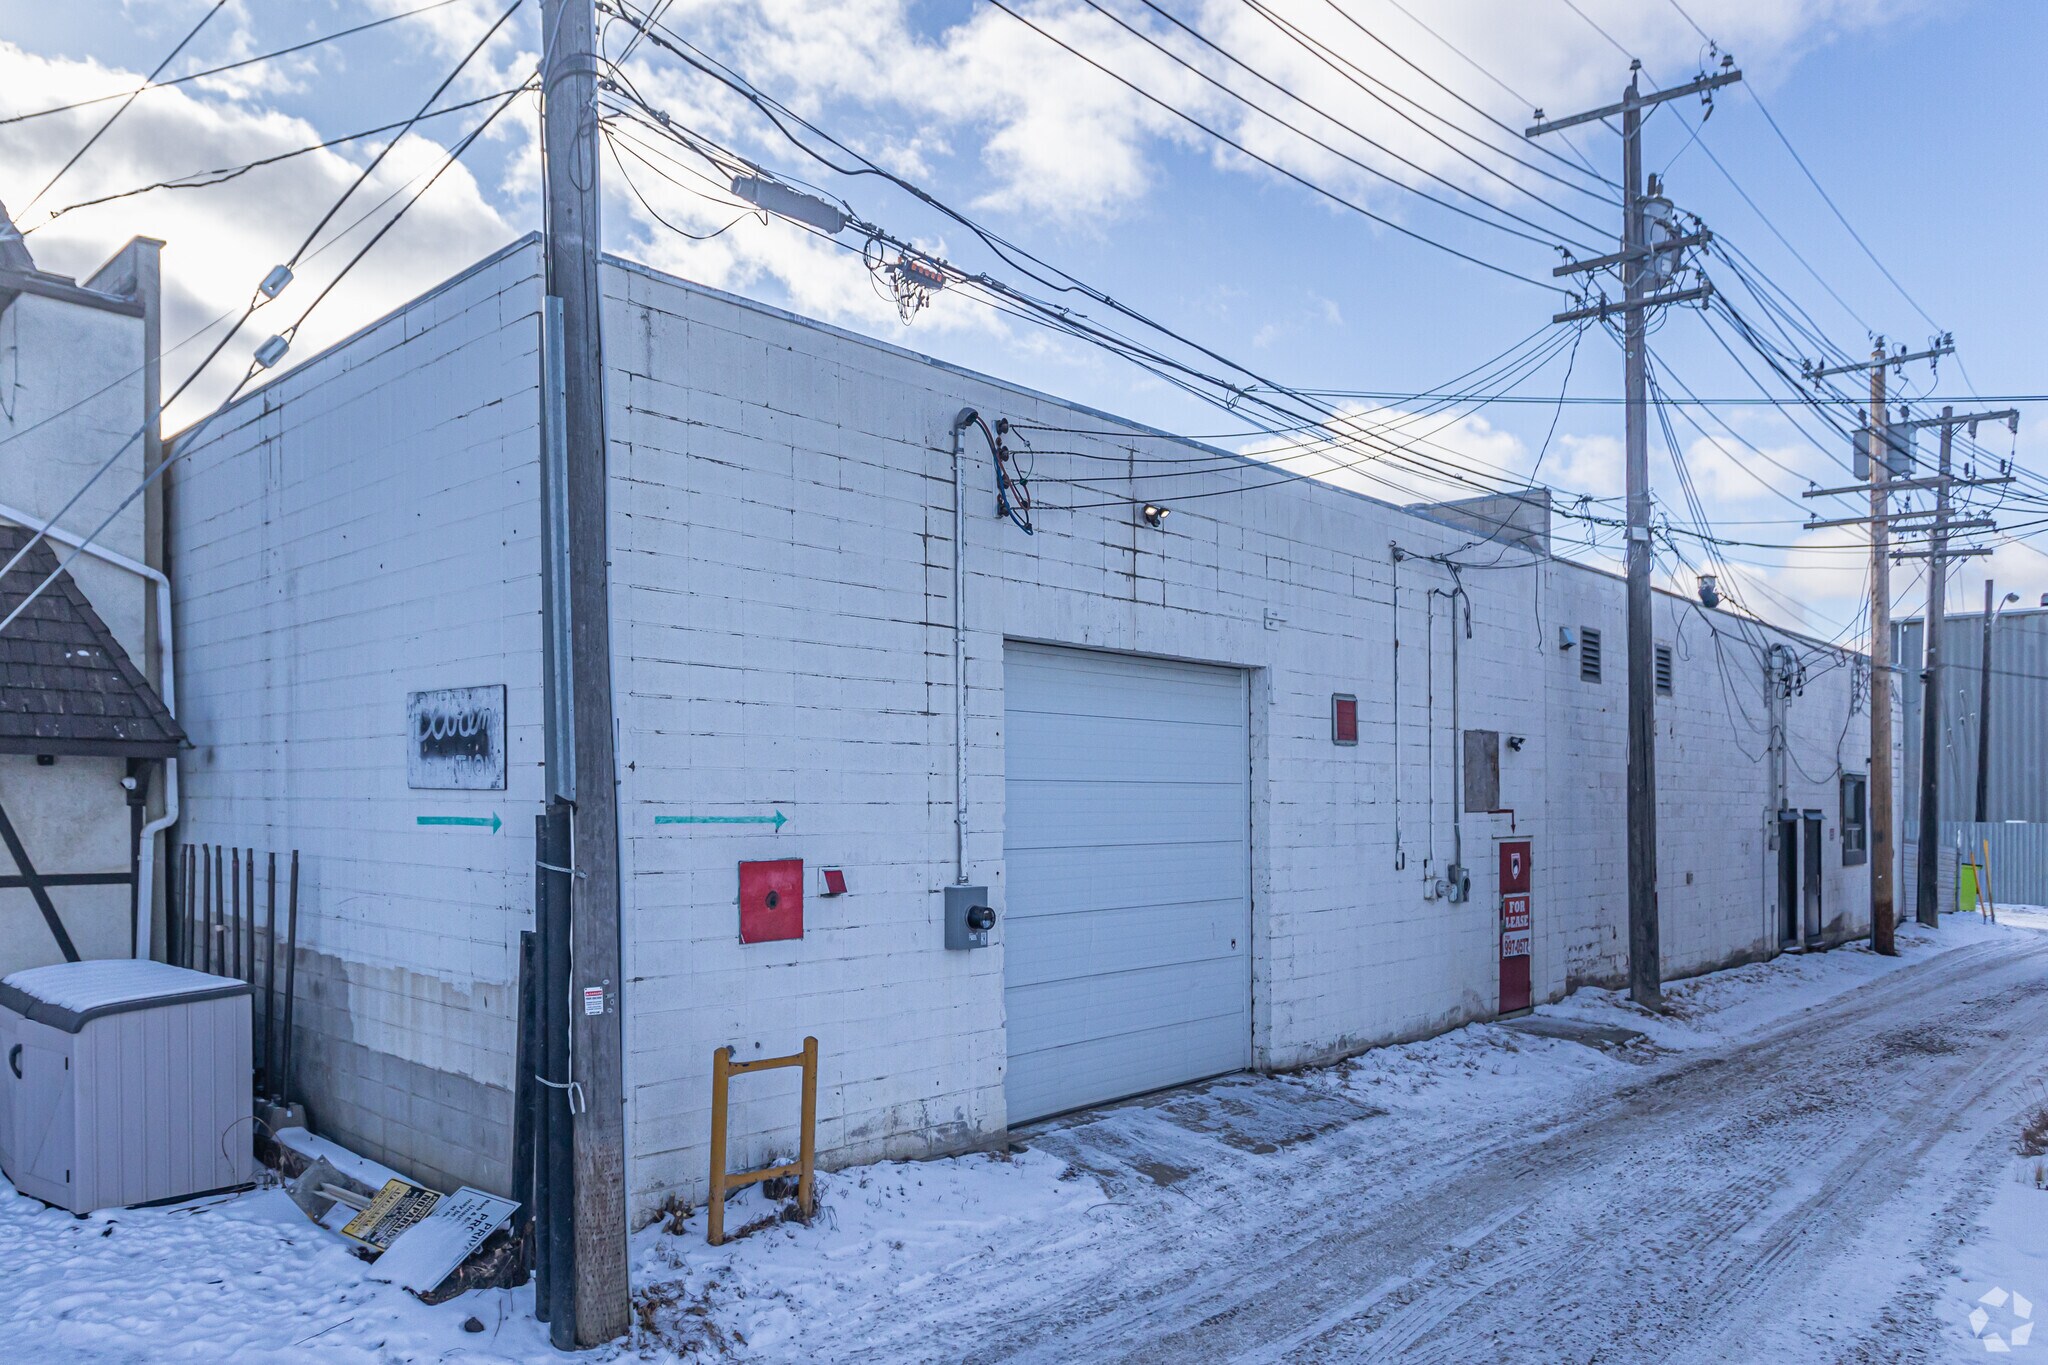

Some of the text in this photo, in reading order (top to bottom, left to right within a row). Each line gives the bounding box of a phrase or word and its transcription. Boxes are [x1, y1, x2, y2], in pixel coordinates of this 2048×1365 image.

[1509, 901, 1525, 914] FOR
[1505, 915, 1529, 928] LEASE
[415, 1194, 431, 1207] NO
[380, 1206, 420, 1244] PARKING
